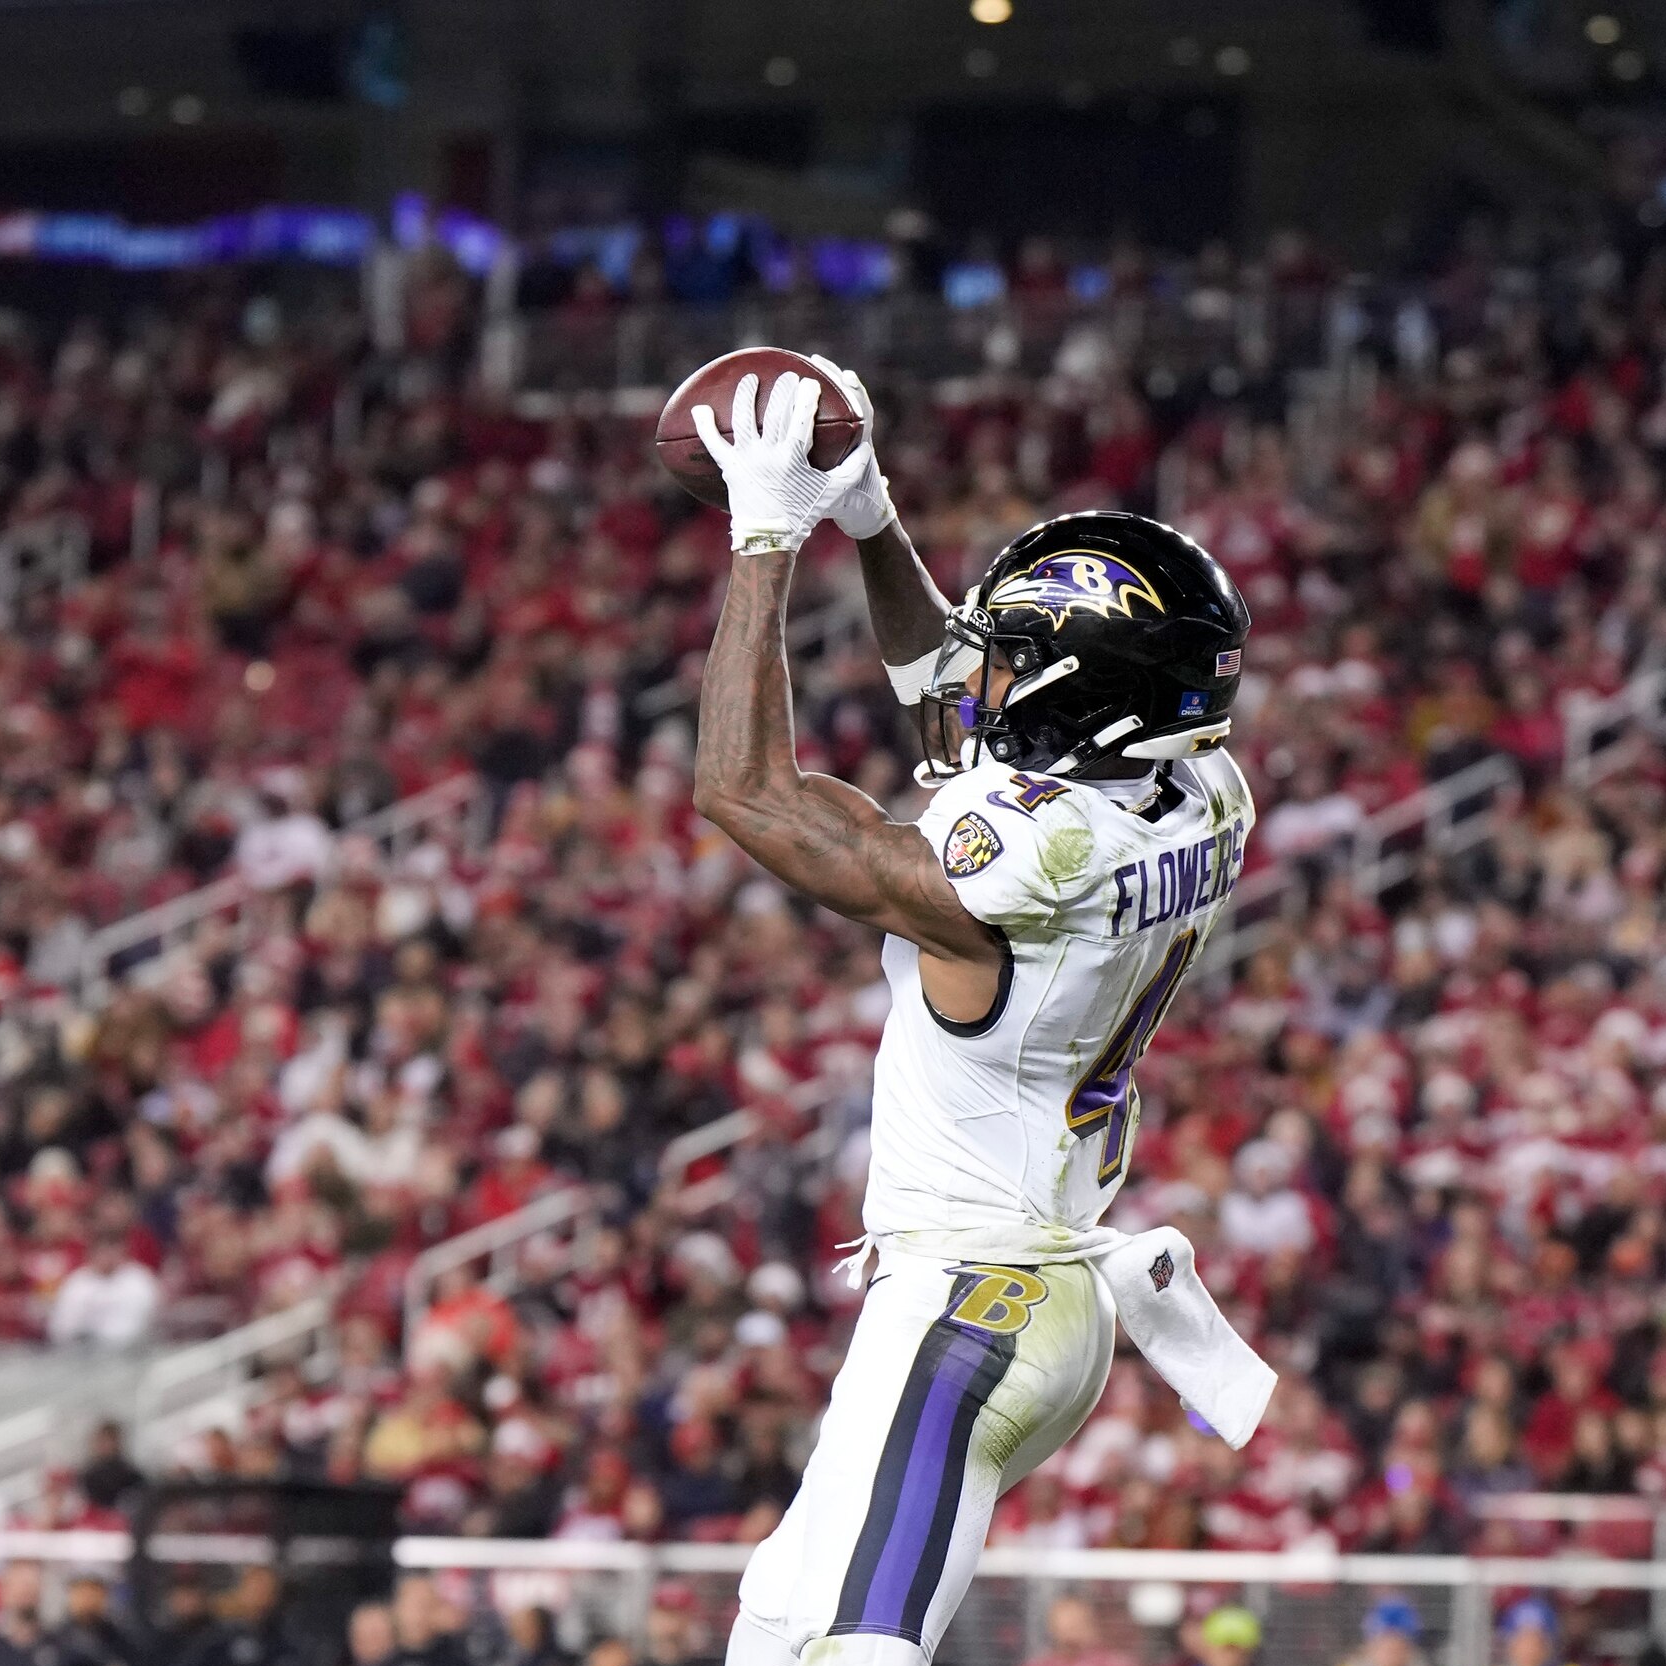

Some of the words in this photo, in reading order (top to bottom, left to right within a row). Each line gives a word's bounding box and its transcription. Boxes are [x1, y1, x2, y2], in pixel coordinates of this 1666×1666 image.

[967, 813, 1000, 851] RAVENS
[1009, 772, 1072, 814] 4
[1111, 817, 1245, 937] FLOWERS
[1064, 927, 1199, 1190] 4
